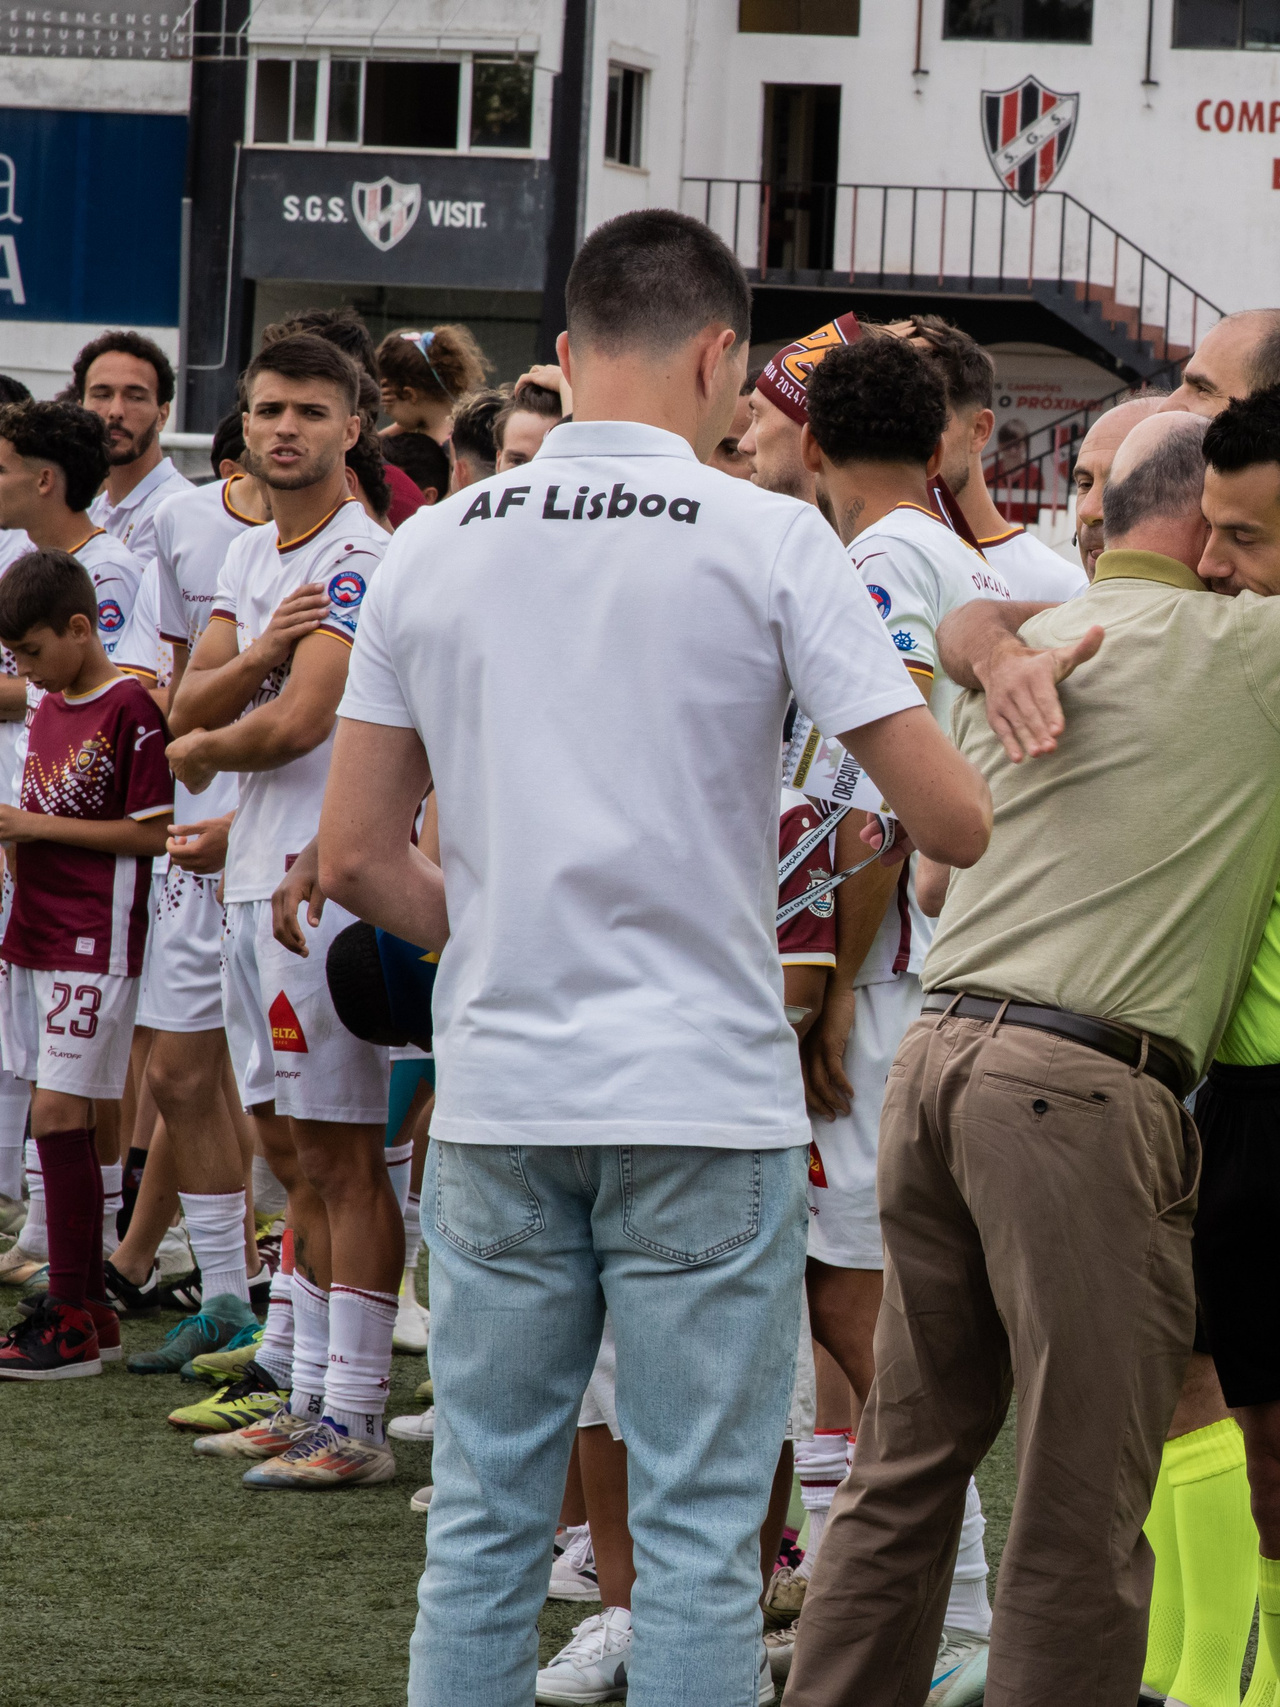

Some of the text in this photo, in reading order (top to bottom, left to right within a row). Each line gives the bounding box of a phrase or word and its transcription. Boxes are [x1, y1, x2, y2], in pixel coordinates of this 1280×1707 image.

[283, 195, 488, 228] S.G.S. VISIT.
[459, 482, 702, 527] AF Lisboa
[831, 750, 862, 801] ORGANI
[801, 827, 827, 852] FUTEBOL
[825, 819, 834, 828] DE
[46, 982, 102, 1039] 23
[49, 1050, 82, 1060] PLAYOFF
